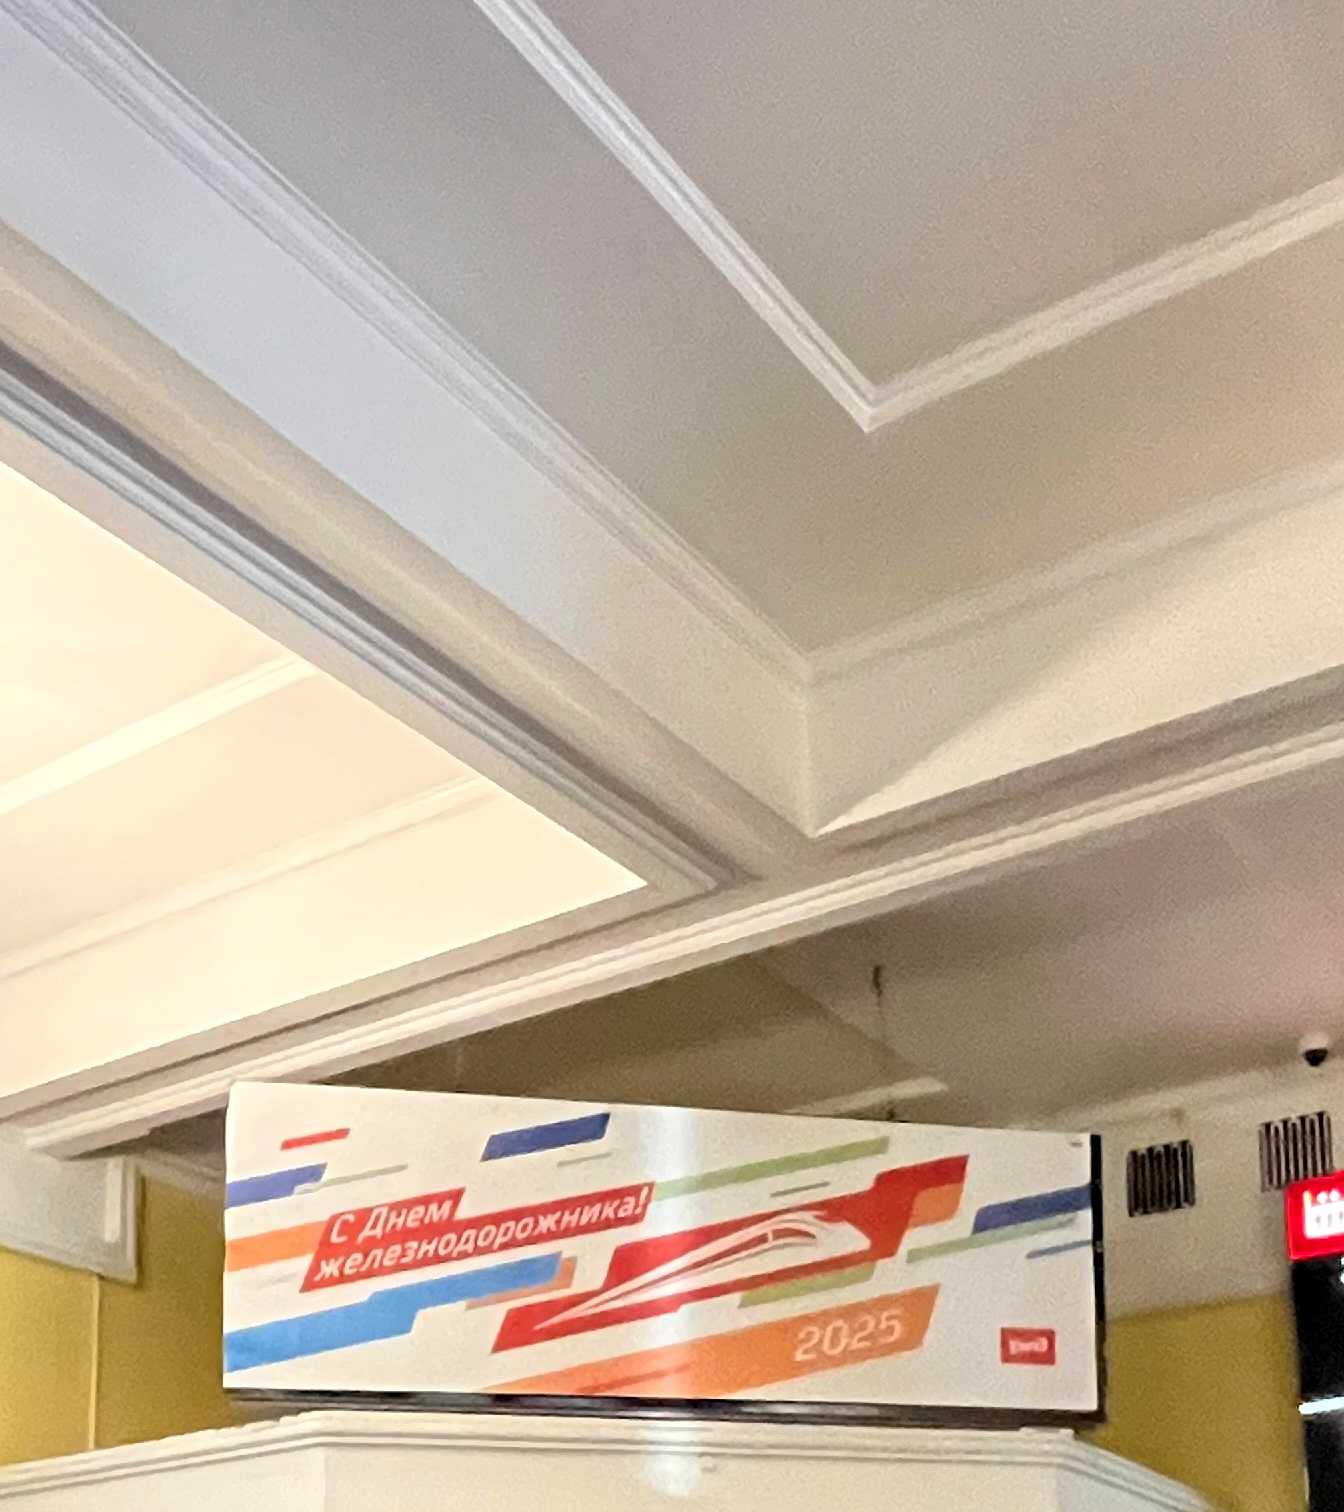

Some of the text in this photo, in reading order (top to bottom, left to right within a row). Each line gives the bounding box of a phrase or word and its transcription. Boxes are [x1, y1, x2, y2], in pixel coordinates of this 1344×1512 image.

[313, 1186, 650, 1282] железнодорожника!
[330, 1199, 454, 1244] С Днем
[795, 1309, 902, 1361] 2025
